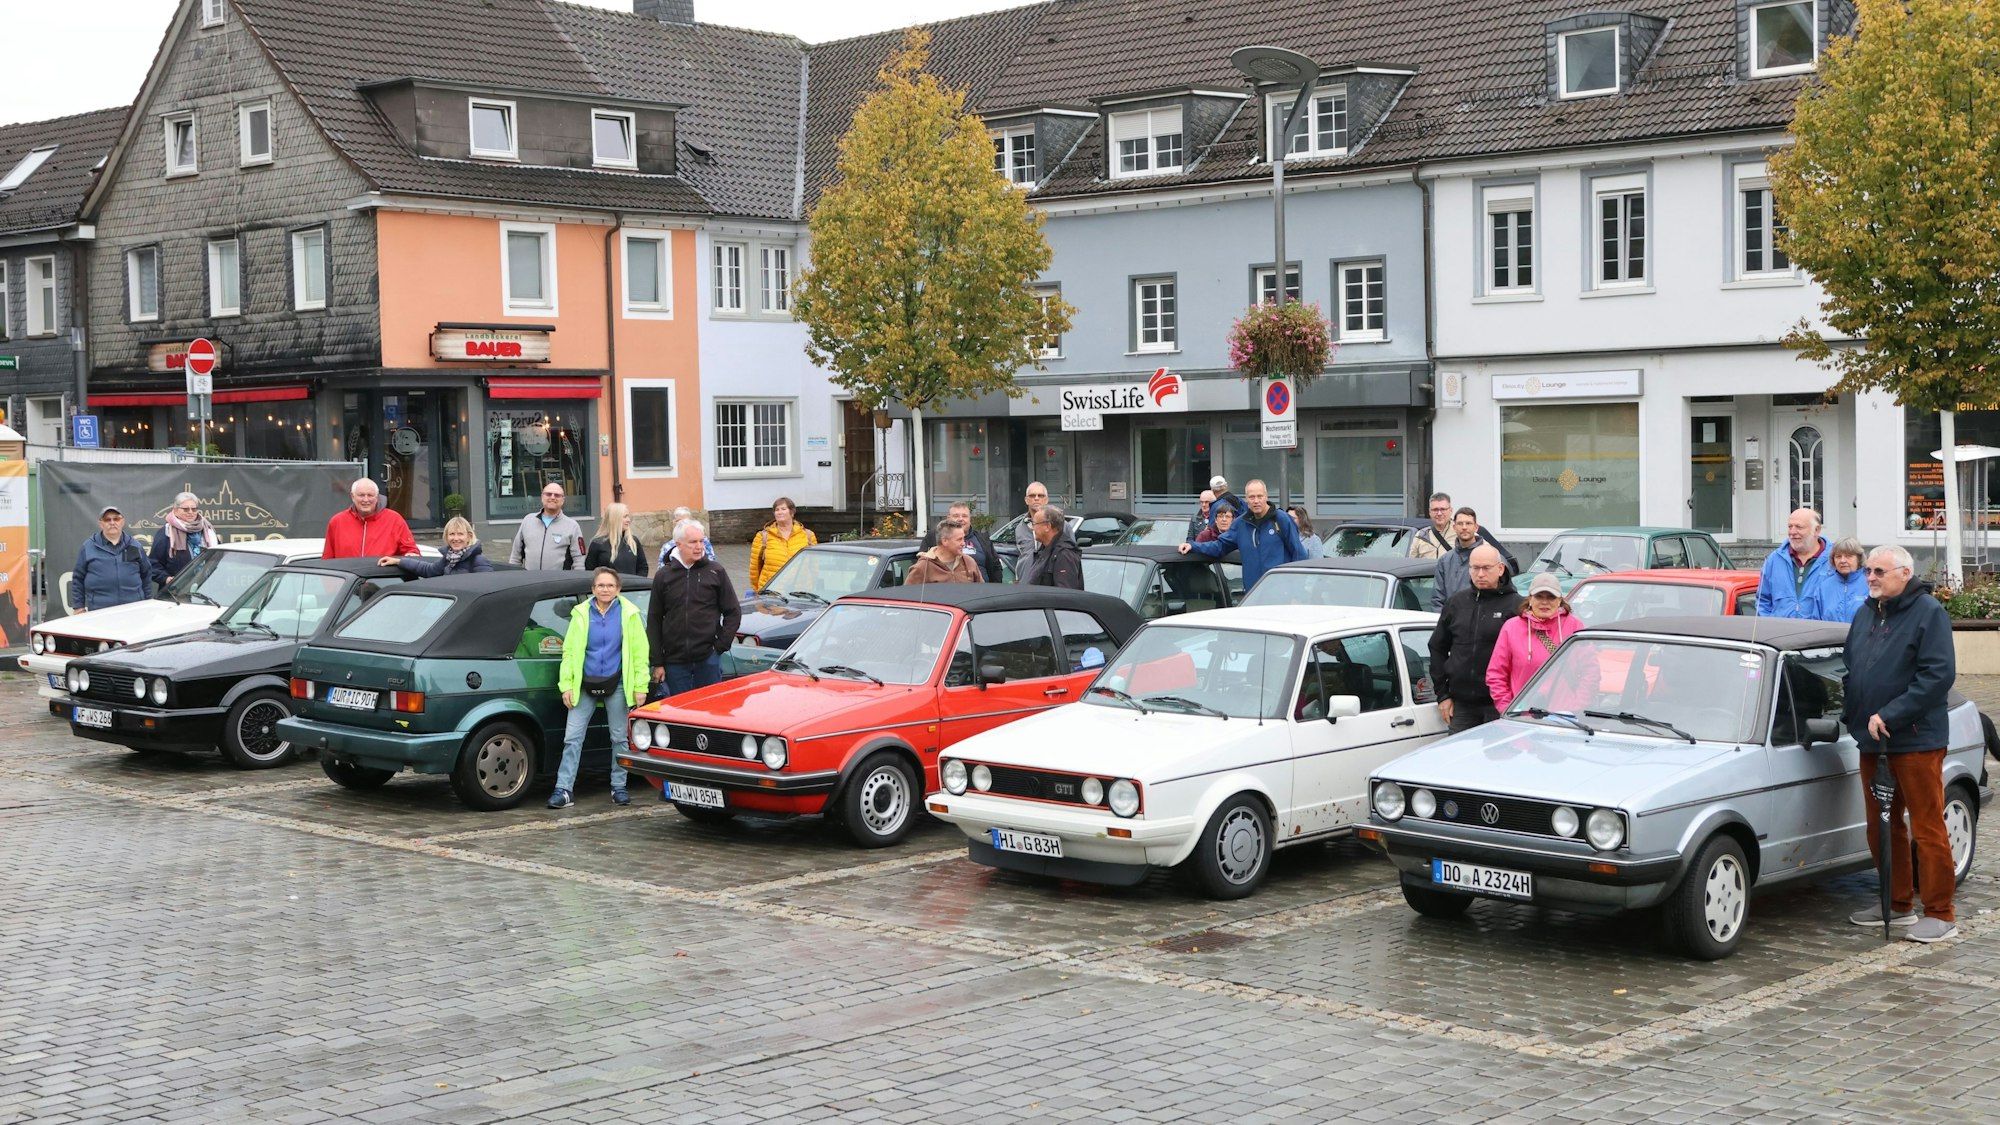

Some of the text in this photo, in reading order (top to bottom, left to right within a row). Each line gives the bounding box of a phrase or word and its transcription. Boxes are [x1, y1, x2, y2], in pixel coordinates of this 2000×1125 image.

[465, 341, 522, 357] BAUER
[1063, 414, 1097, 428] Select
[994, 446, 1000, 456] 3
[1578, 476, 1607, 484] Lounge
[332, 688, 346, 704] AUR
[99, 711, 112, 725] 266
[669, 784, 681, 799] KU
[686, 787, 698, 802] WV
[699, 789, 718, 804] 85H
[1055, 783, 1073, 795] GTI
[999, 832, 1061, 855] HI G 83H
[1443, 863, 1461, 882] DO
[1472, 868, 1481, 886] A
[1484, 870, 1530, 894] 2324H
